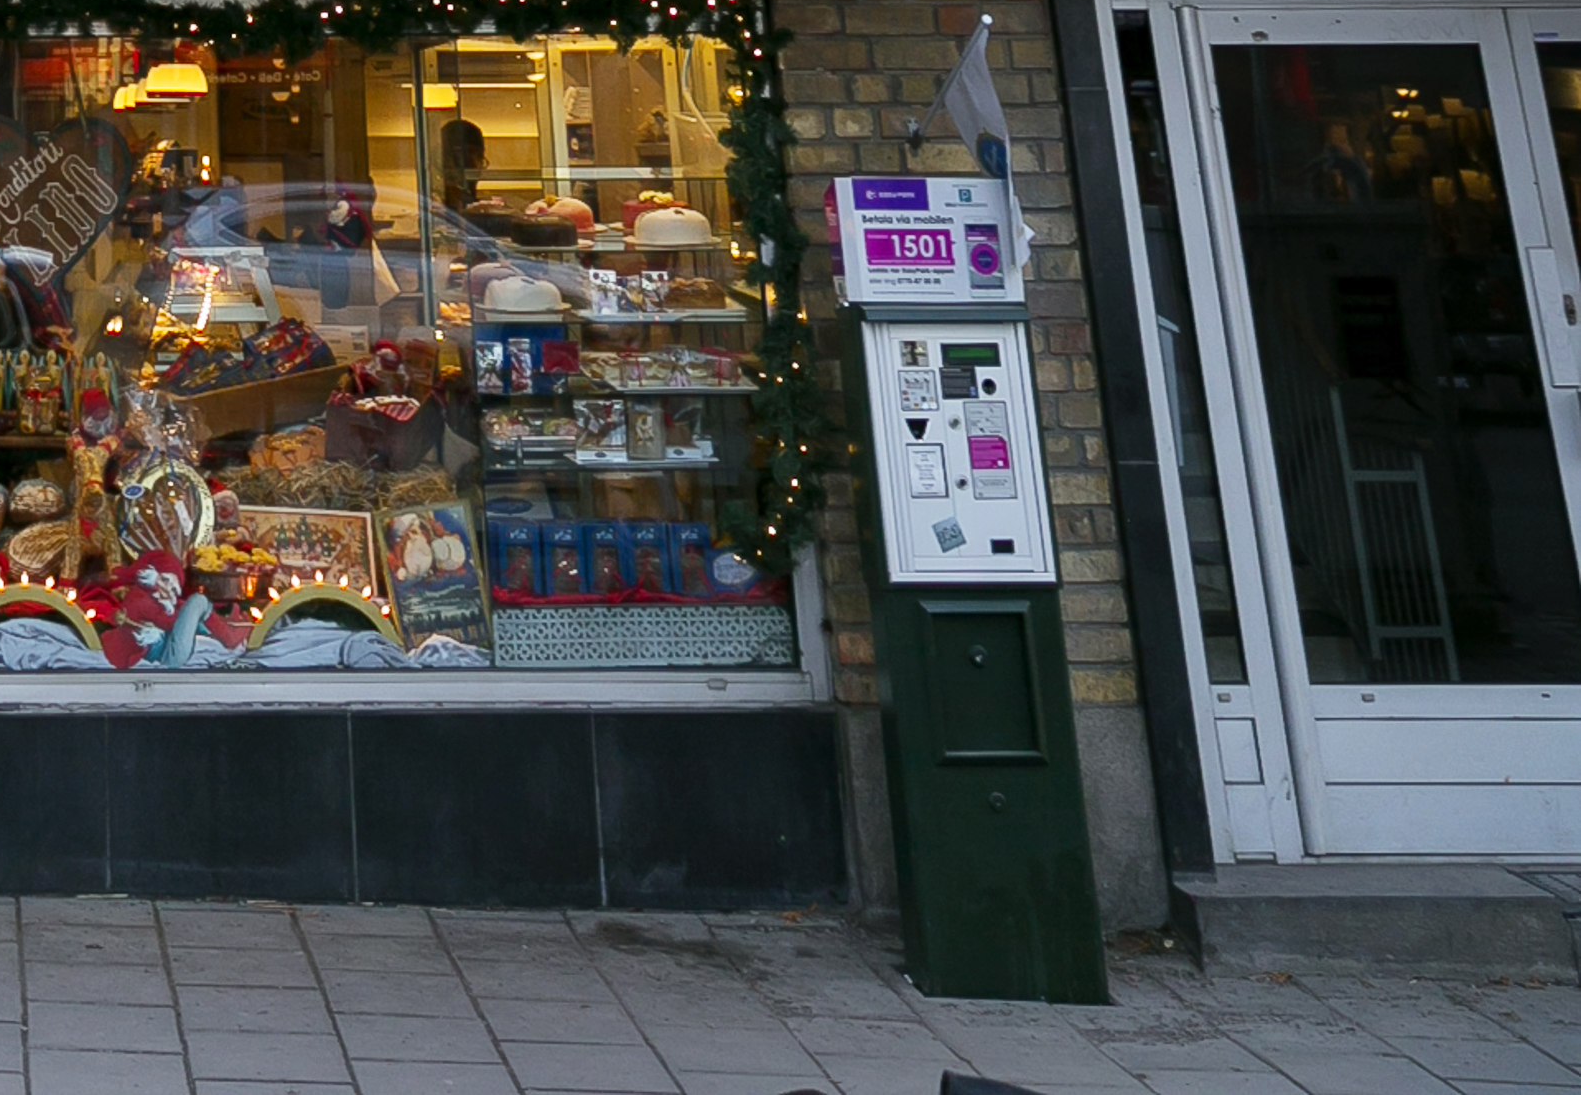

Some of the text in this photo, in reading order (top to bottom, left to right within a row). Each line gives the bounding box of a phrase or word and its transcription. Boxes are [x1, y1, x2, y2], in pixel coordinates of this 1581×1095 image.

[2, 153, 119, 287] LIDO
[861, 214, 954, 225] Betala via mobilen
[890, 234, 948, 258] 1501
